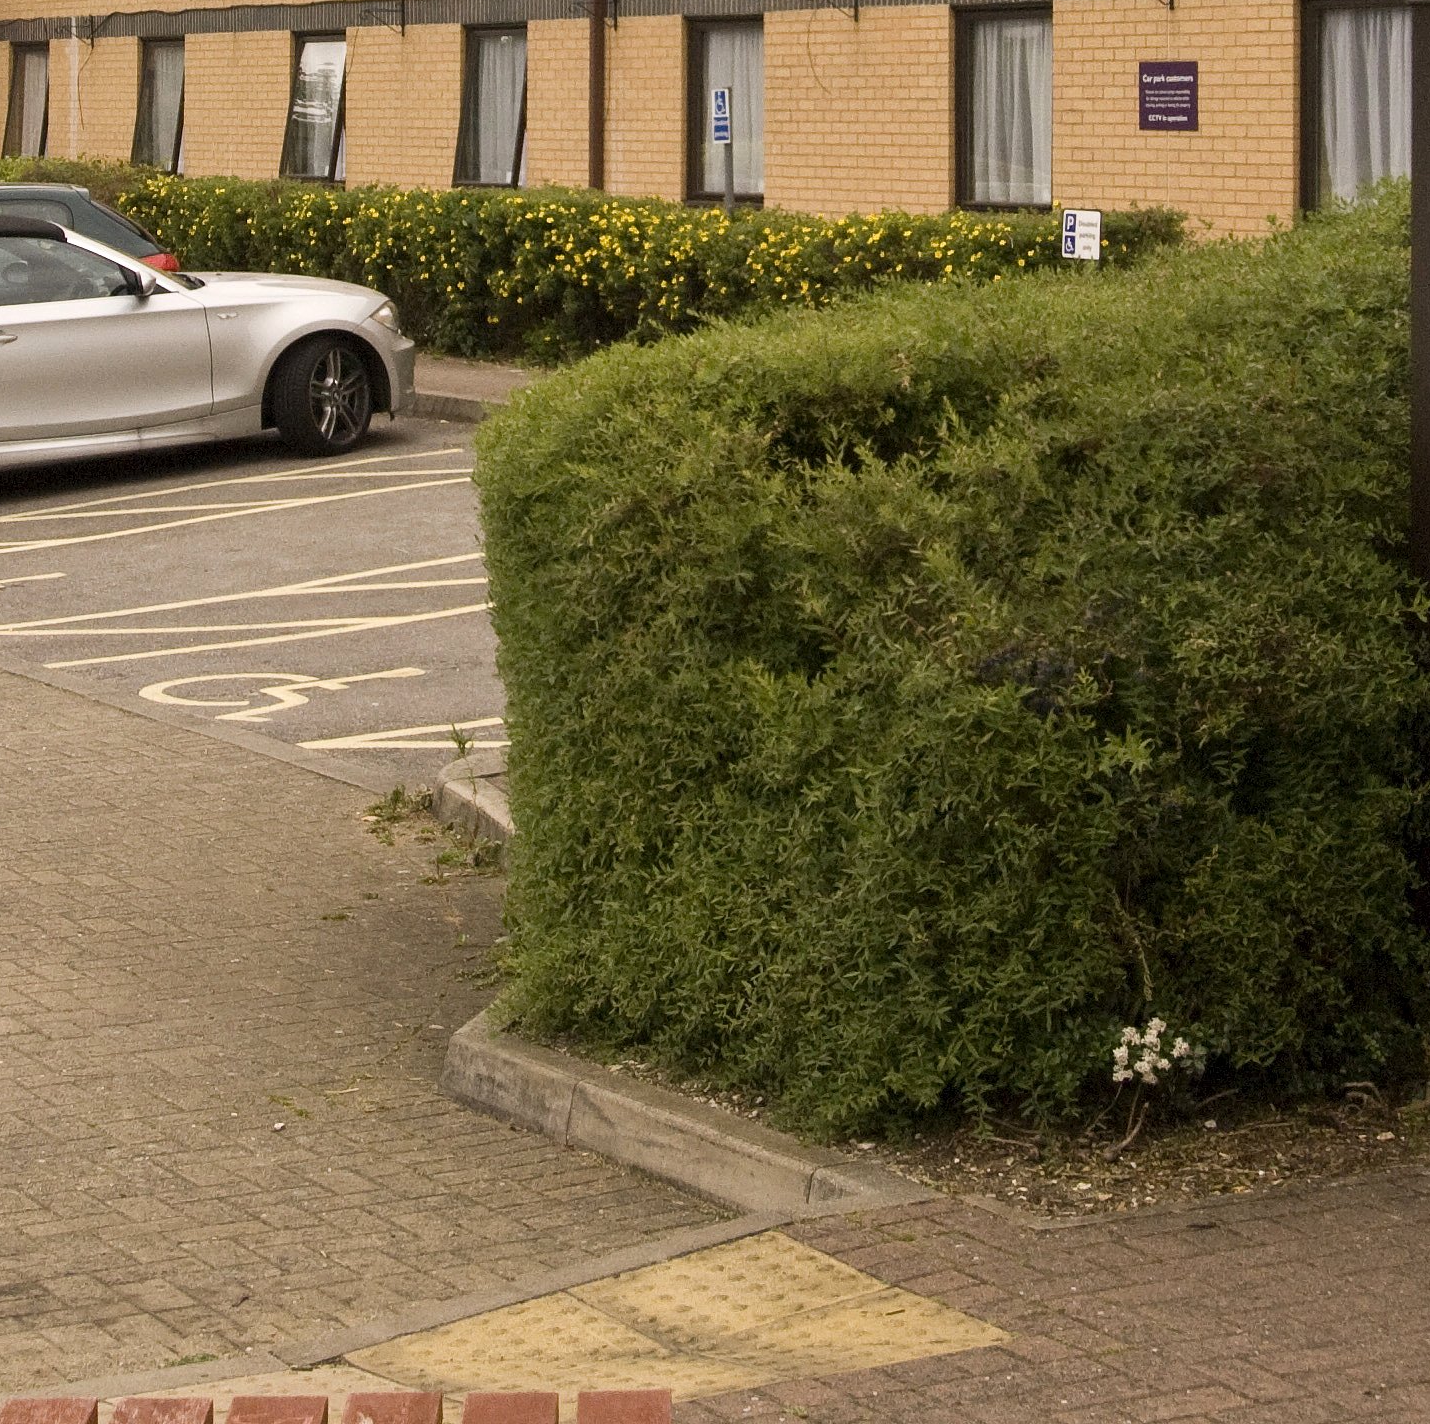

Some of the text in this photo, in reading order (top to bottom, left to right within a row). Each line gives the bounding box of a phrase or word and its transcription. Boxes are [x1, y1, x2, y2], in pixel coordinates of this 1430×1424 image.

[1142, 74, 1153, 83] Car
[1153, 74, 1165, 84] park
[1148, 114, 1162, 122] CCTV
[1067, 216, 1074, 230] P
